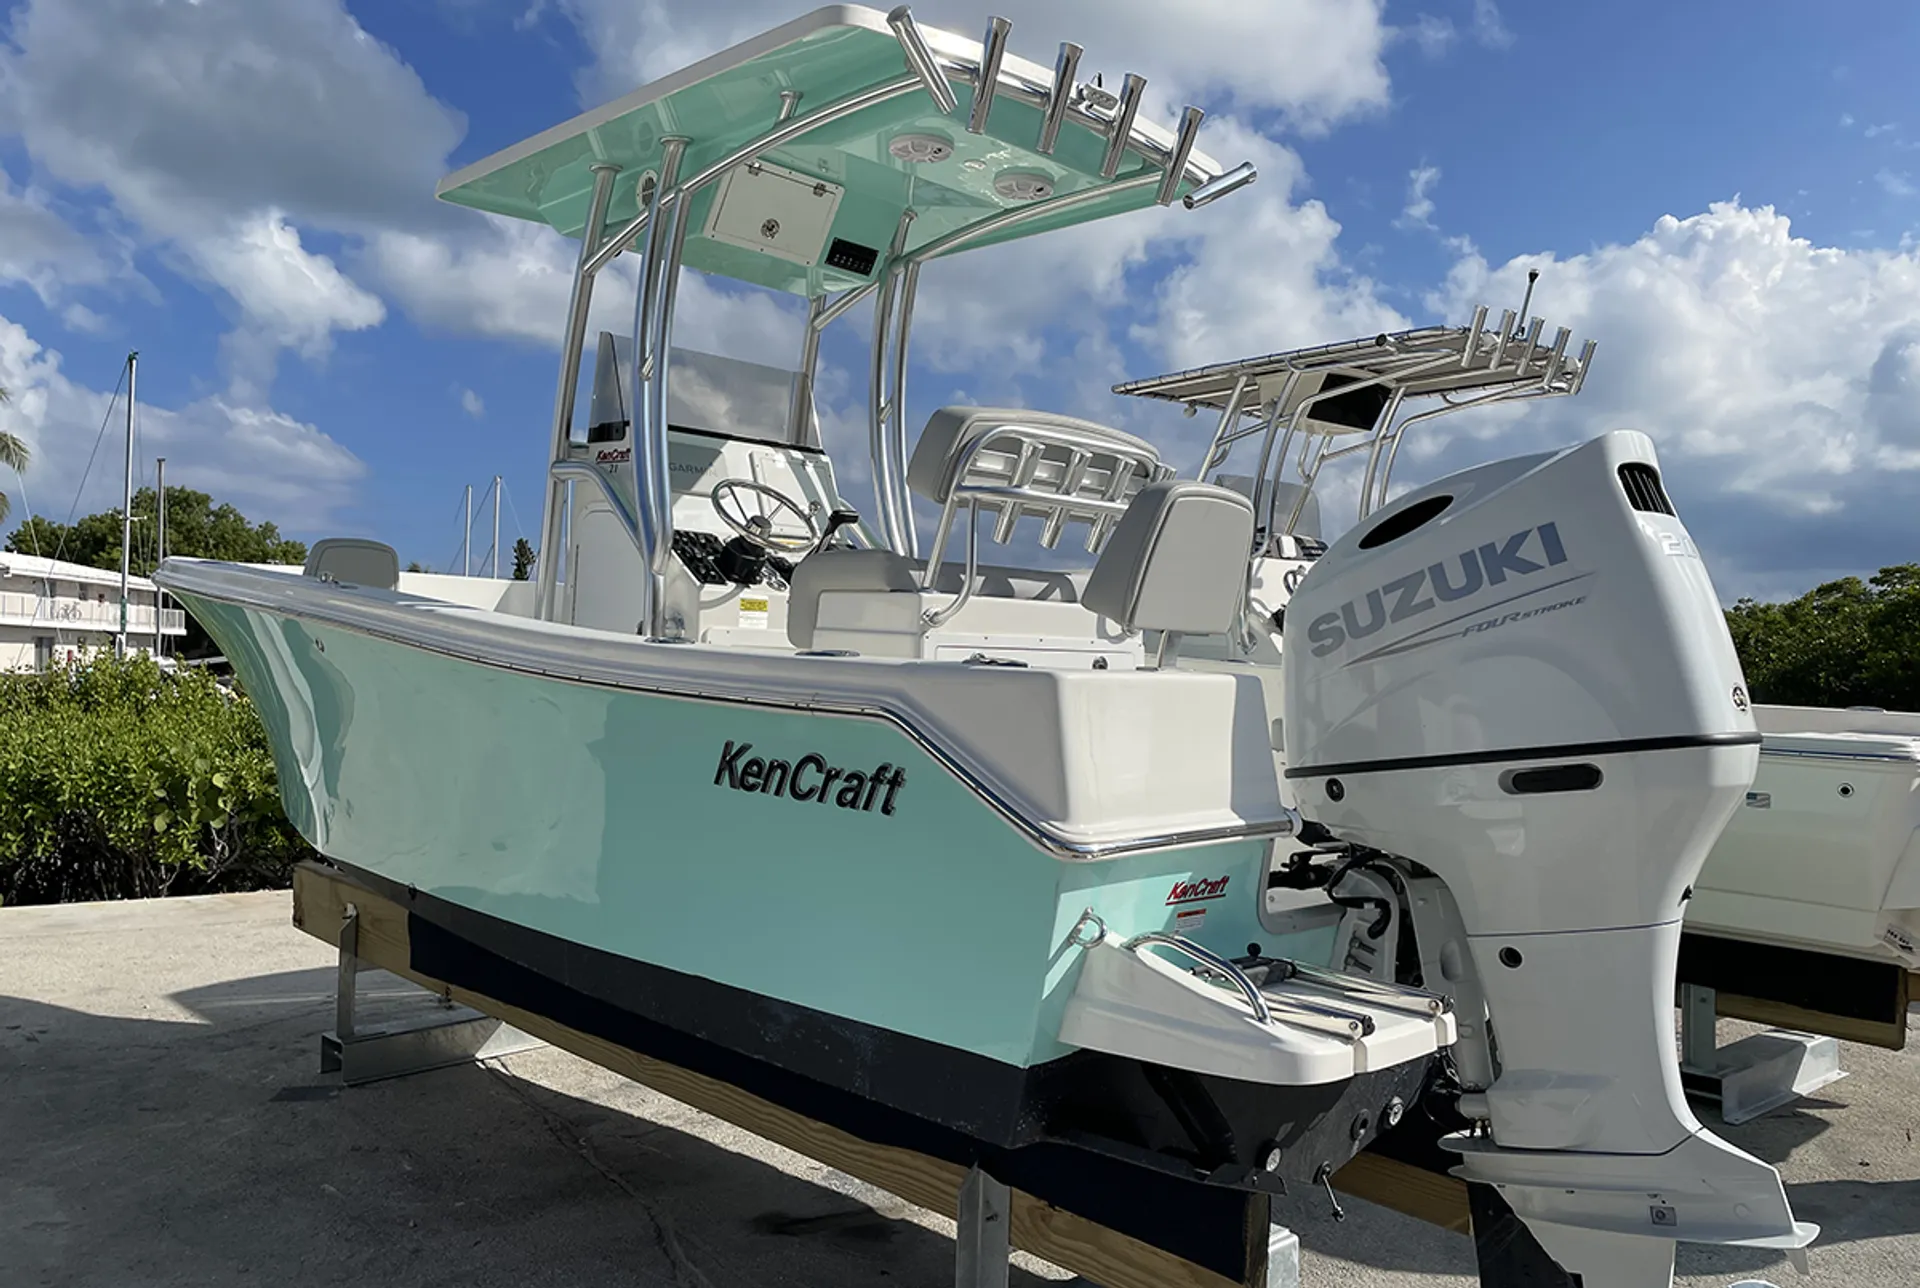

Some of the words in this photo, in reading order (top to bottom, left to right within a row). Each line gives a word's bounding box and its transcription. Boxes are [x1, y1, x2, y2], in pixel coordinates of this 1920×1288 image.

[668, 462, 719, 478] GARMIN
[1307, 521, 1568, 658] SUZUKI
[1461, 611, 1521, 638] FOUR
[1520, 595, 1587, 620] STROKE
[714, 740, 906, 816] KenCraft
[1167, 875, 1230, 901] KenCraft
